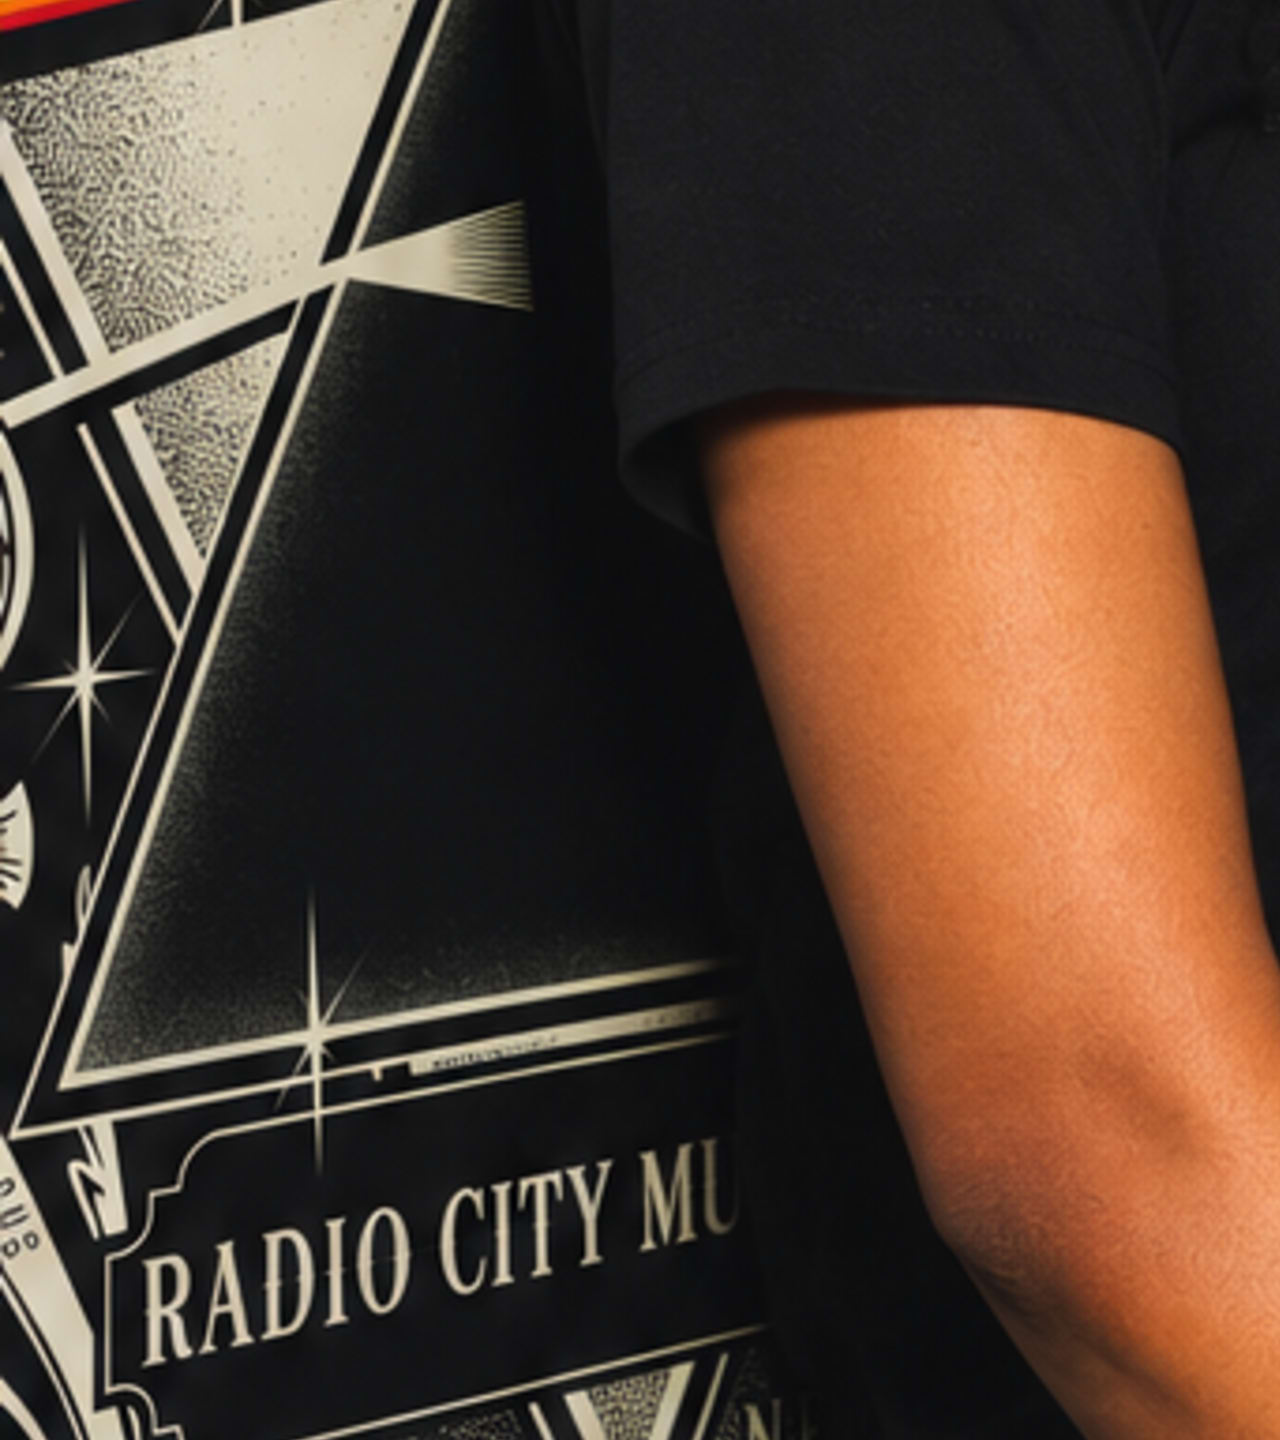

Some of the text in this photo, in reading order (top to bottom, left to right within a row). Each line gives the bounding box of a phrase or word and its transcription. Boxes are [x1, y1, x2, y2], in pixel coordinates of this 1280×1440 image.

[141, 1205, 411, 1369] RADIO
[439, 1157, 613, 1296] CITY
[638, 1136, 739, 1251] MU
